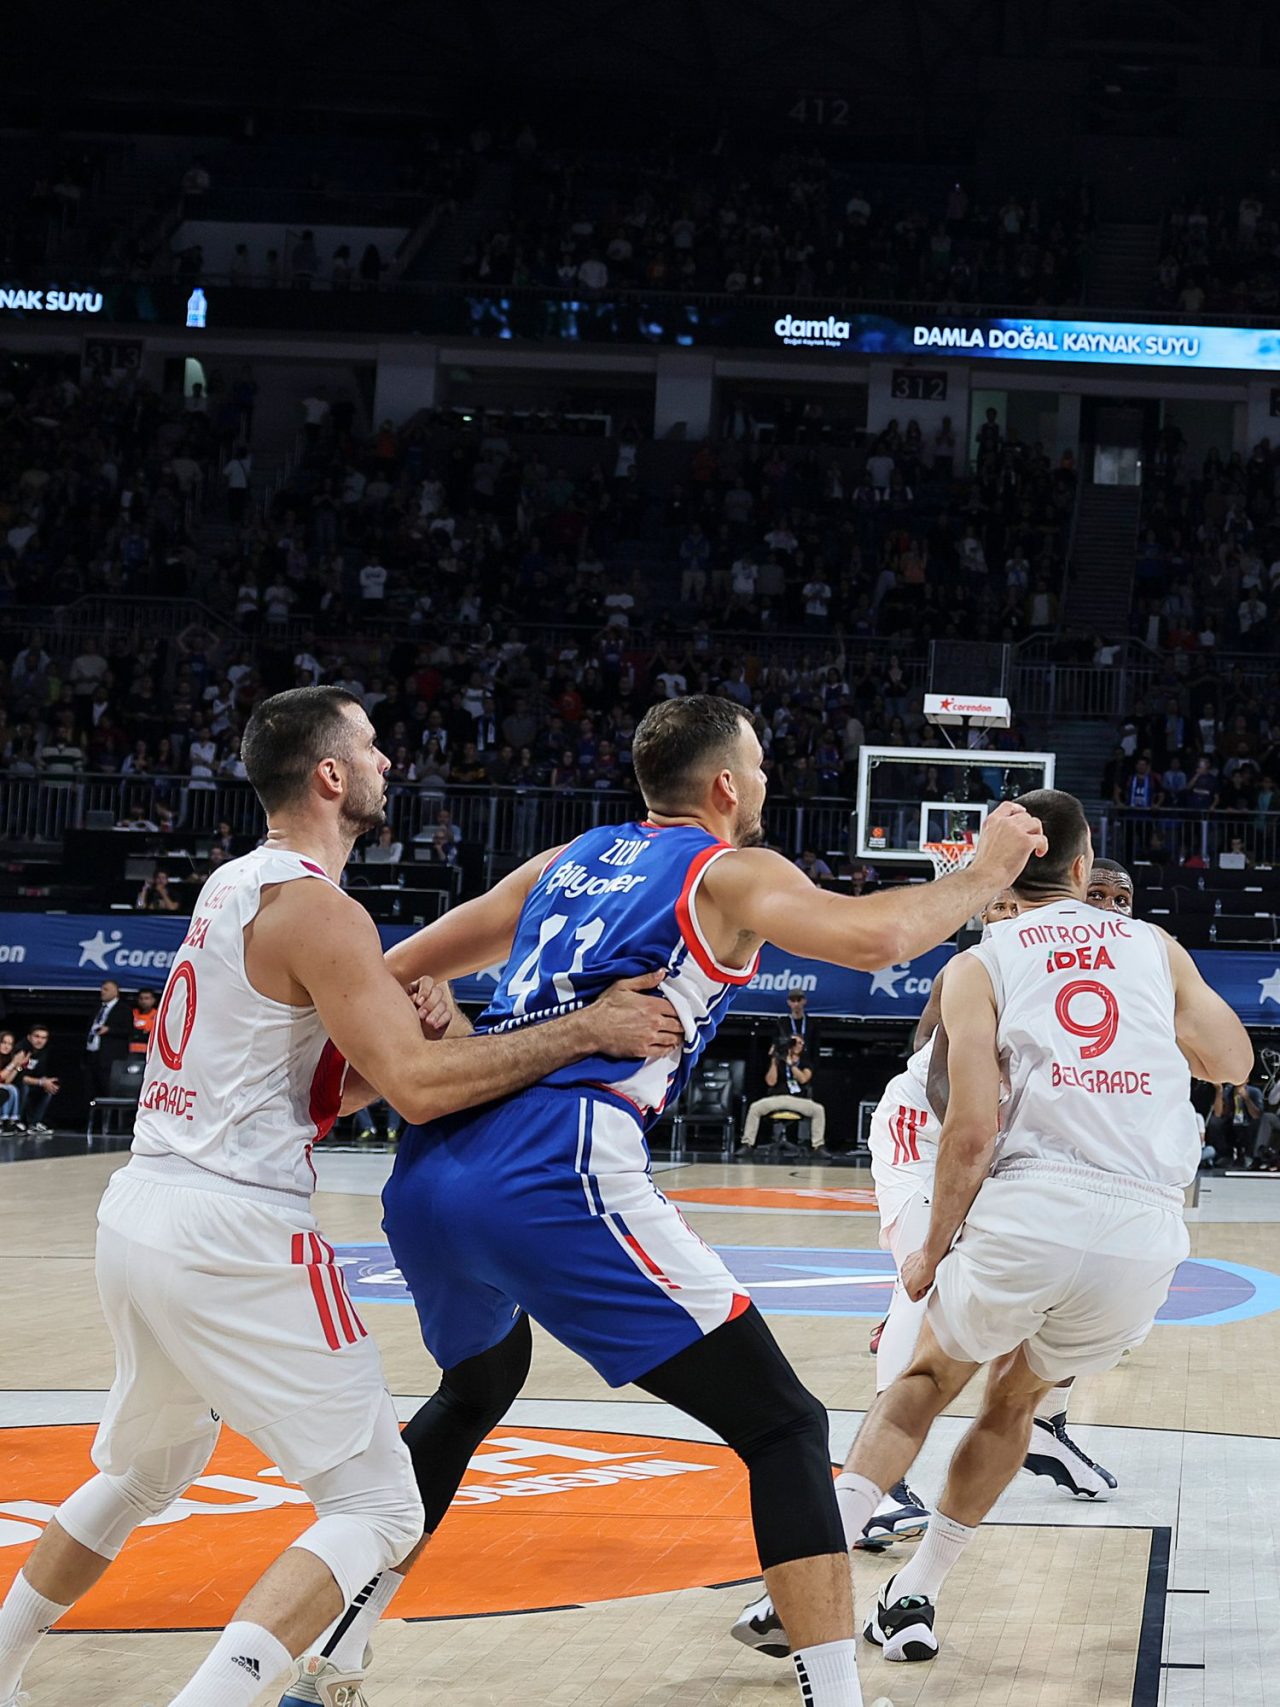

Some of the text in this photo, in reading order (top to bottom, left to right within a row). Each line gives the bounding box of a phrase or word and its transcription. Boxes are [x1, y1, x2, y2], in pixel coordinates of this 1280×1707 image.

[788, 99, 848, 125] 412
[0, 289, 103, 313] NAK SUYU
[774, 314, 850, 339] damla
[913, 326, 1198, 356] DAMLA DOĞAL KAYNAK SUYU
[896, 377, 945, 400] 312
[507, 913, 606, 1018] 41
[750, 969, 817, 992] endon
[146, 960, 197, 1071] 0
[1055, 979, 1120, 1060] 9
[1052, 1062, 1153, 1096] BELGRADE
[139, 1080, 197, 1121] GRADE
[231, 1656, 261, 1681] adidas
